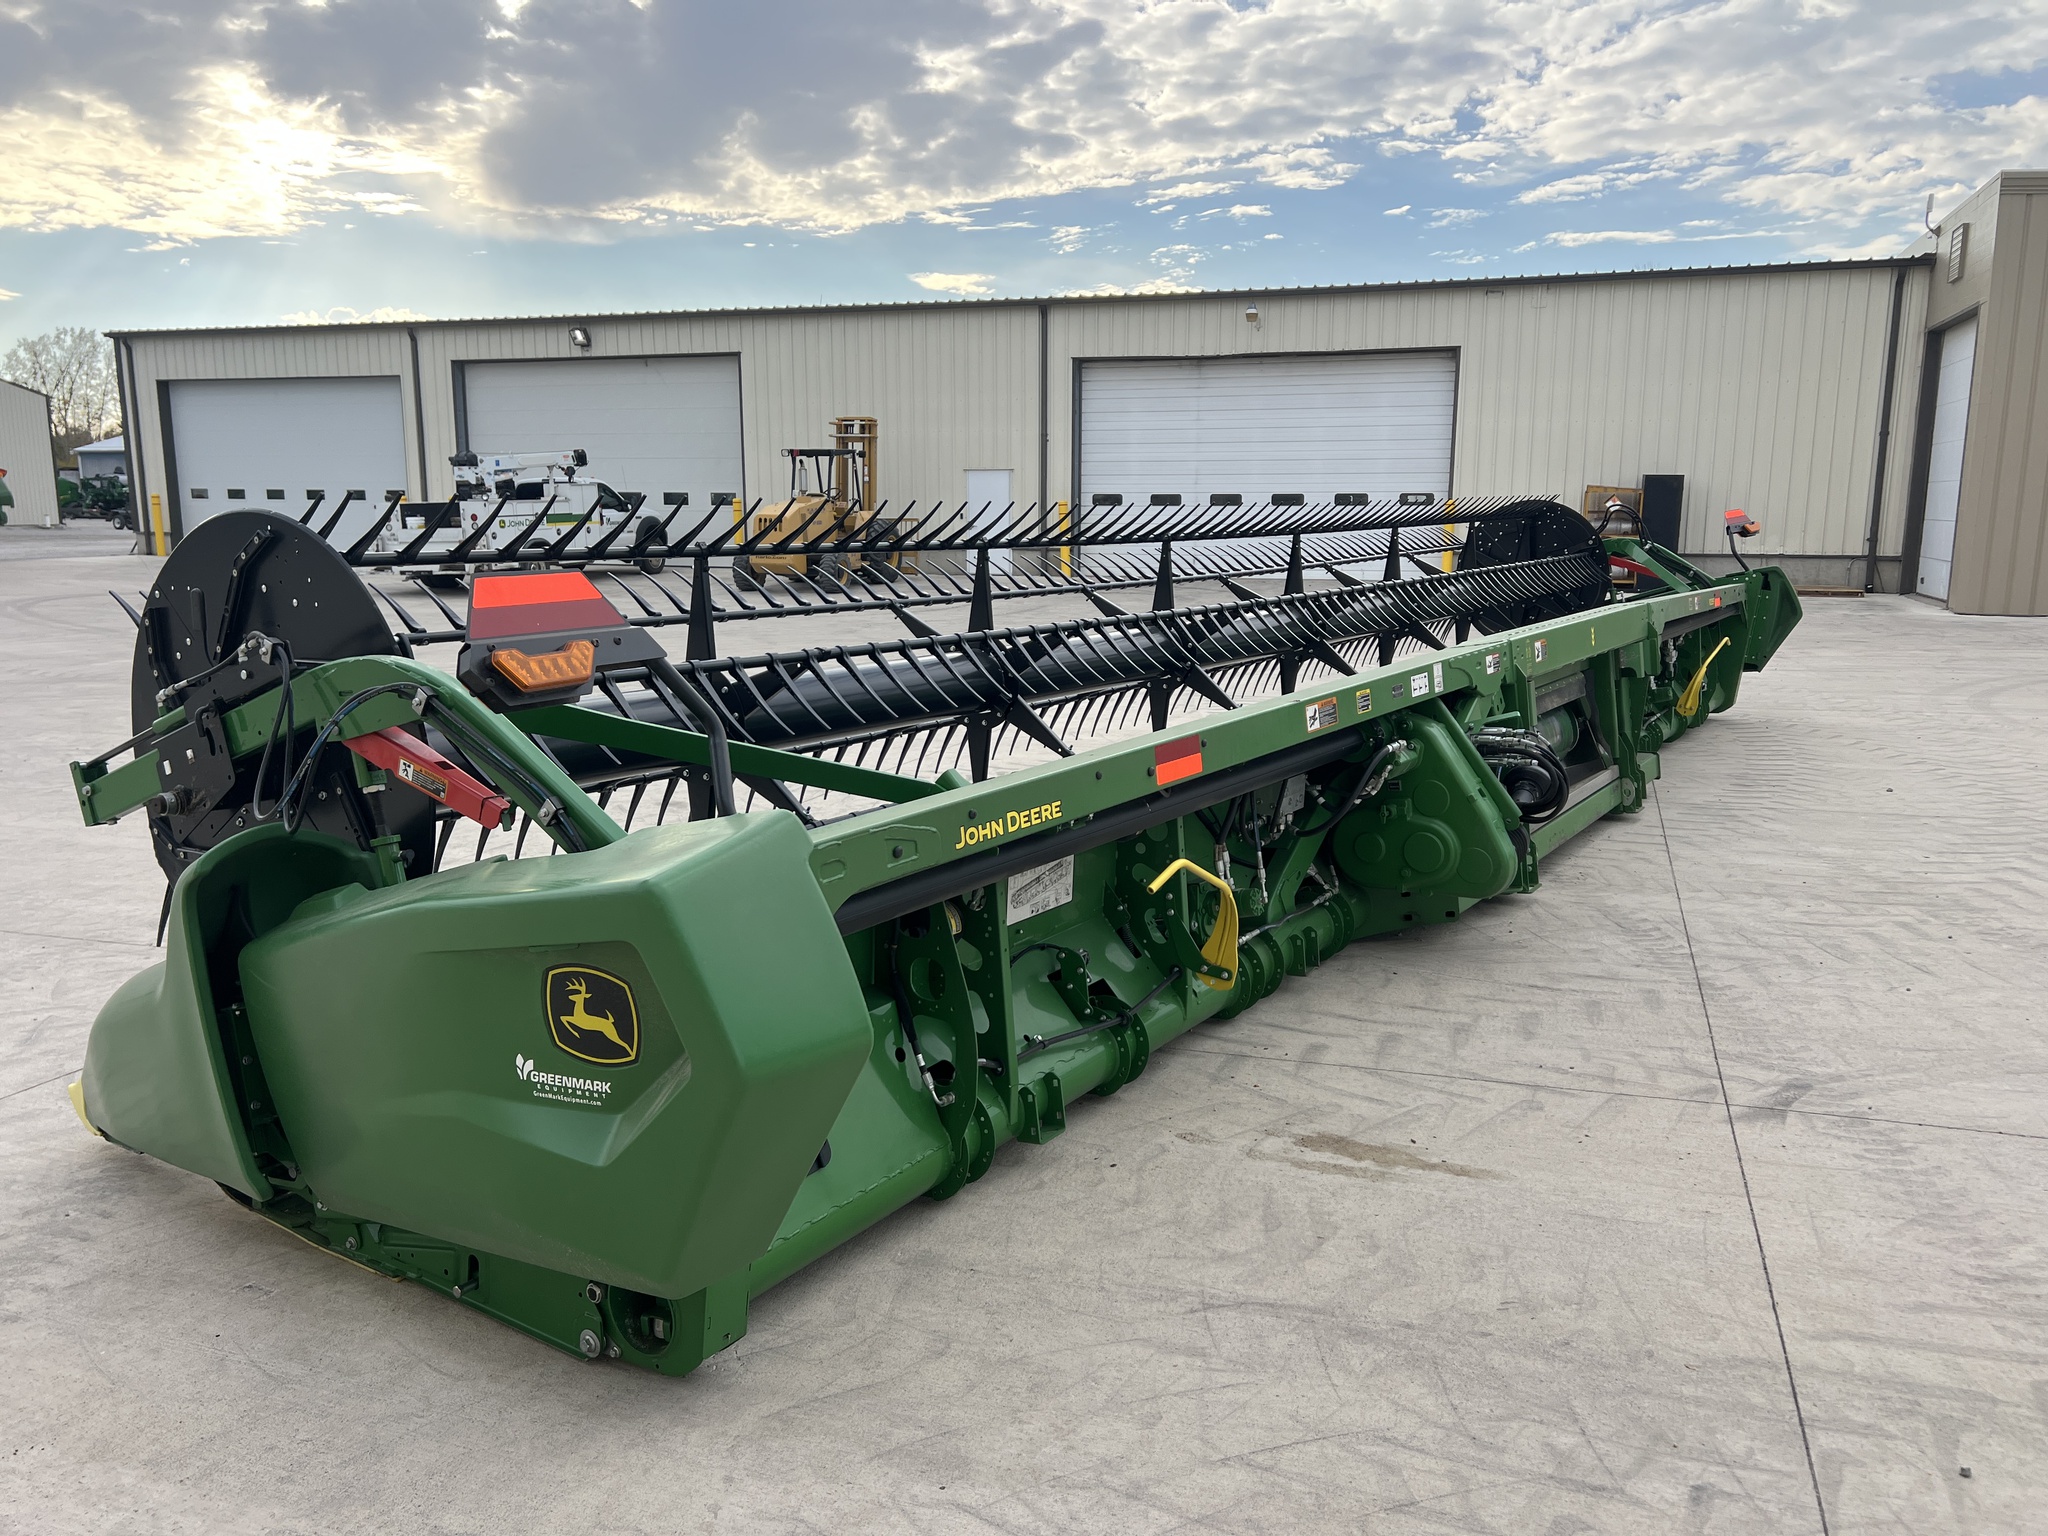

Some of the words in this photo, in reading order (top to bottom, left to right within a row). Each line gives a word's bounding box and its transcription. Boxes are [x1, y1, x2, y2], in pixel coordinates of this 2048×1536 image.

[507, 519, 525, 528] JOHN
[955, 818, 1004, 850] JOHN
[1006, 800, 1063, 833] DEERE
[530, 1070, 612, 1094] GREENMARK
[533, 1090, 602, 1106] GreenMarkEquipment.com
[537, 1083, 606, 1099] EQUIPMENT
